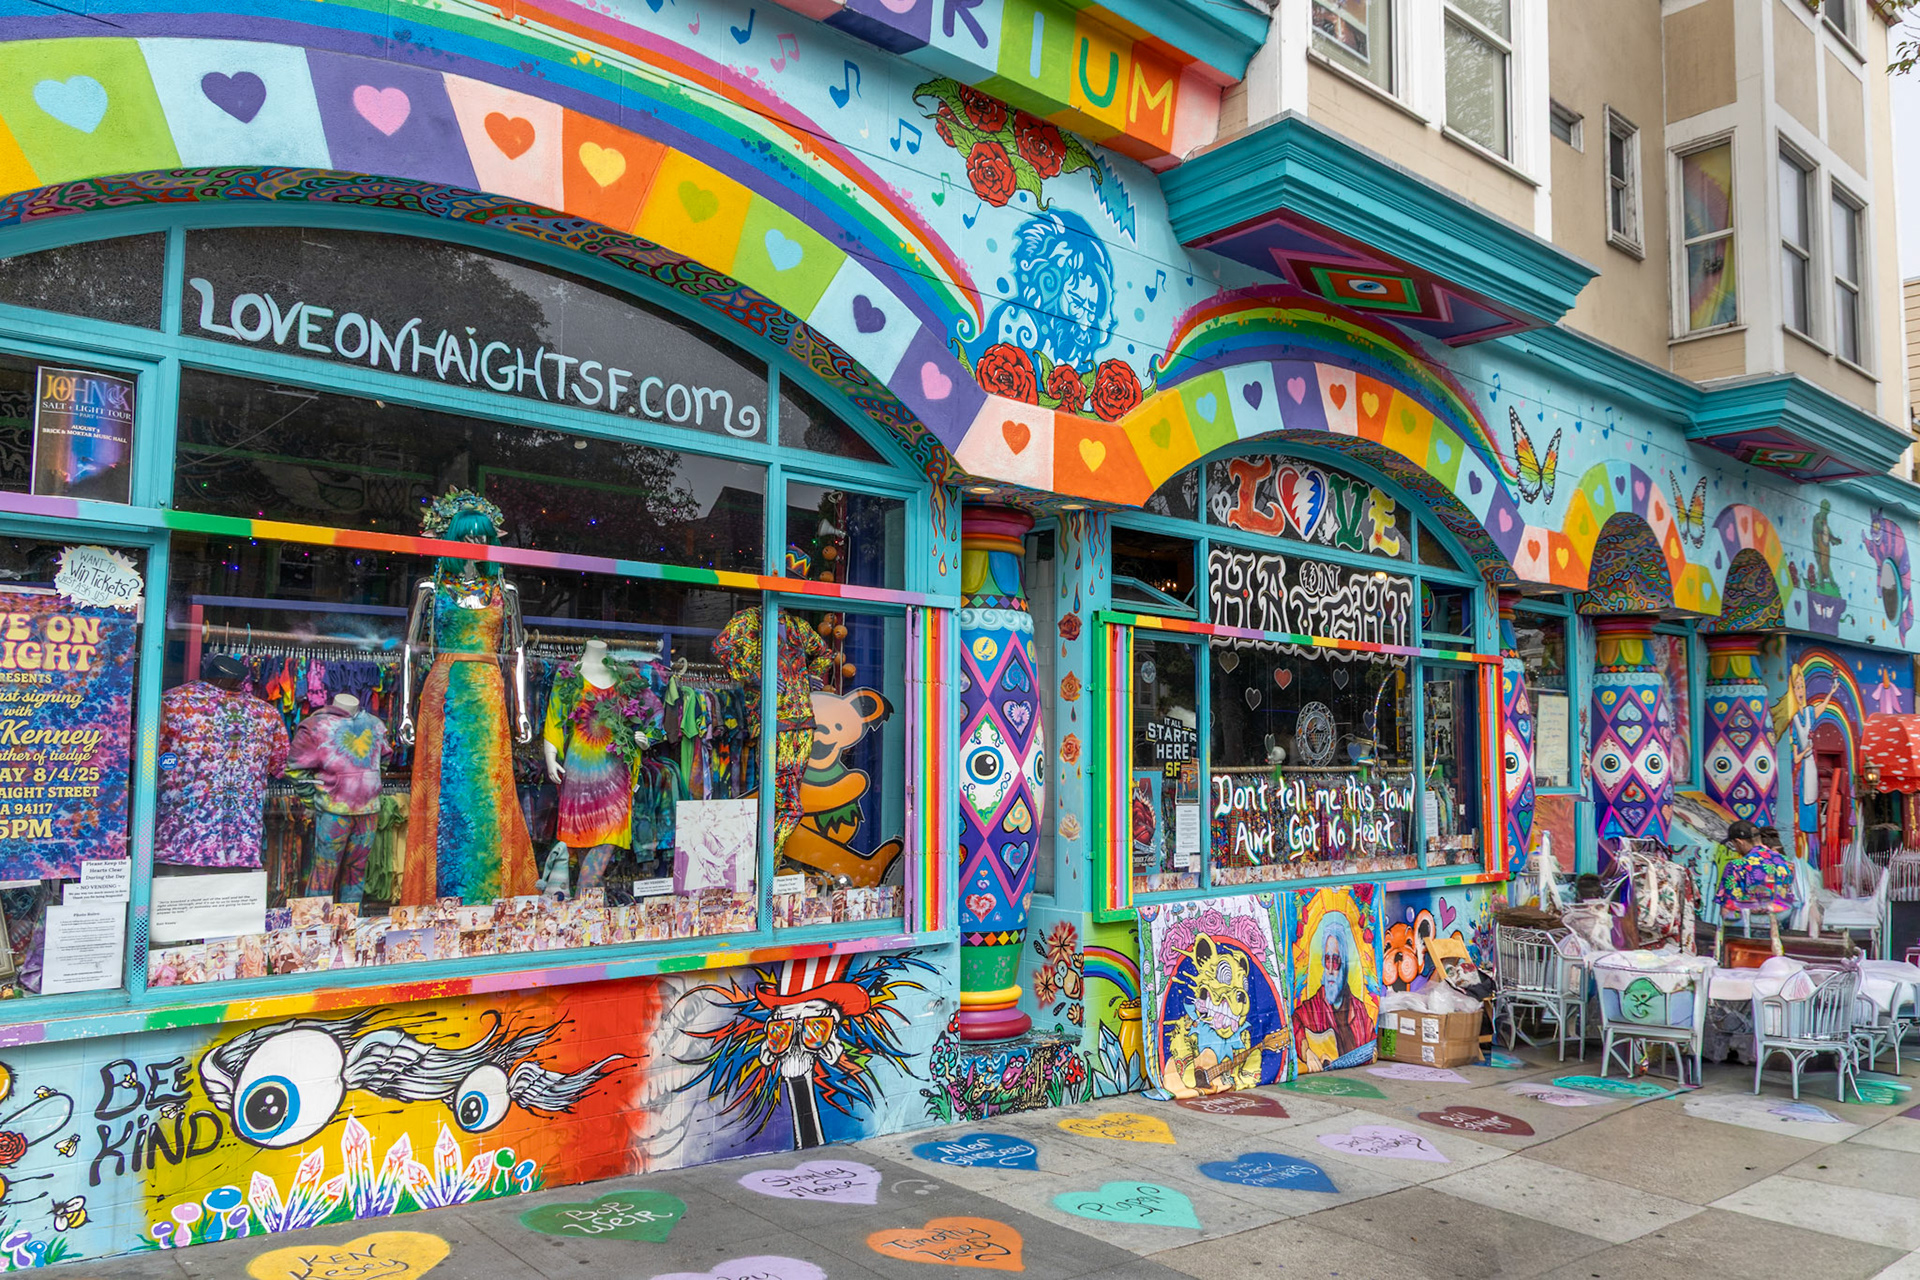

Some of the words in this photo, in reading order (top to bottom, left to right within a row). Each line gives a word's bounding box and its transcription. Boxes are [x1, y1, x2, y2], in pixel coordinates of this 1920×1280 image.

[42, 401, 67, 410] SALT
[75, 405, 105, 415] LIGHT
[107, 409, 132, 421] TOUR
[42, 427, 61, 435] BRICK
[66, 429, 93, 438] MORTAR
[93, 433, 113, 441] MUSIC
[113, 436, 128, 444] HALL
[71, 424, 96, 433] AUGUST
[80, 551, 107, 567] WANT
[107, 560, 117, 574] TO
[73, 582, 91, 596] ASK
[46, 615, 102, 645] ON
[20, 689, 85, 709] signing
[3, 704, 34, 717] with
[1164, 717, 1171, 726] IT
[1170, 719, 1182, 729] ALL
[0, 719, 103, 752] Kenney
[1147, 721, 1197, 743] STARTS
[33, 749, 47, 766] of
[1156, 743, 1190, 760] HERE
[162, 757, 177, 765] ADT
[1165, 761, 1181, 777] SF
[47, 786, 100, 799] STREET
[1276, 776, 1307, 813] tell
[1315, 788, 1342, 815] me
[1344, 775, 1375, 813] this
[14, 803, 53, 815] 94117
[1287, 814, 1321, 861] Got
[1327, 815, 1346, 851] No
